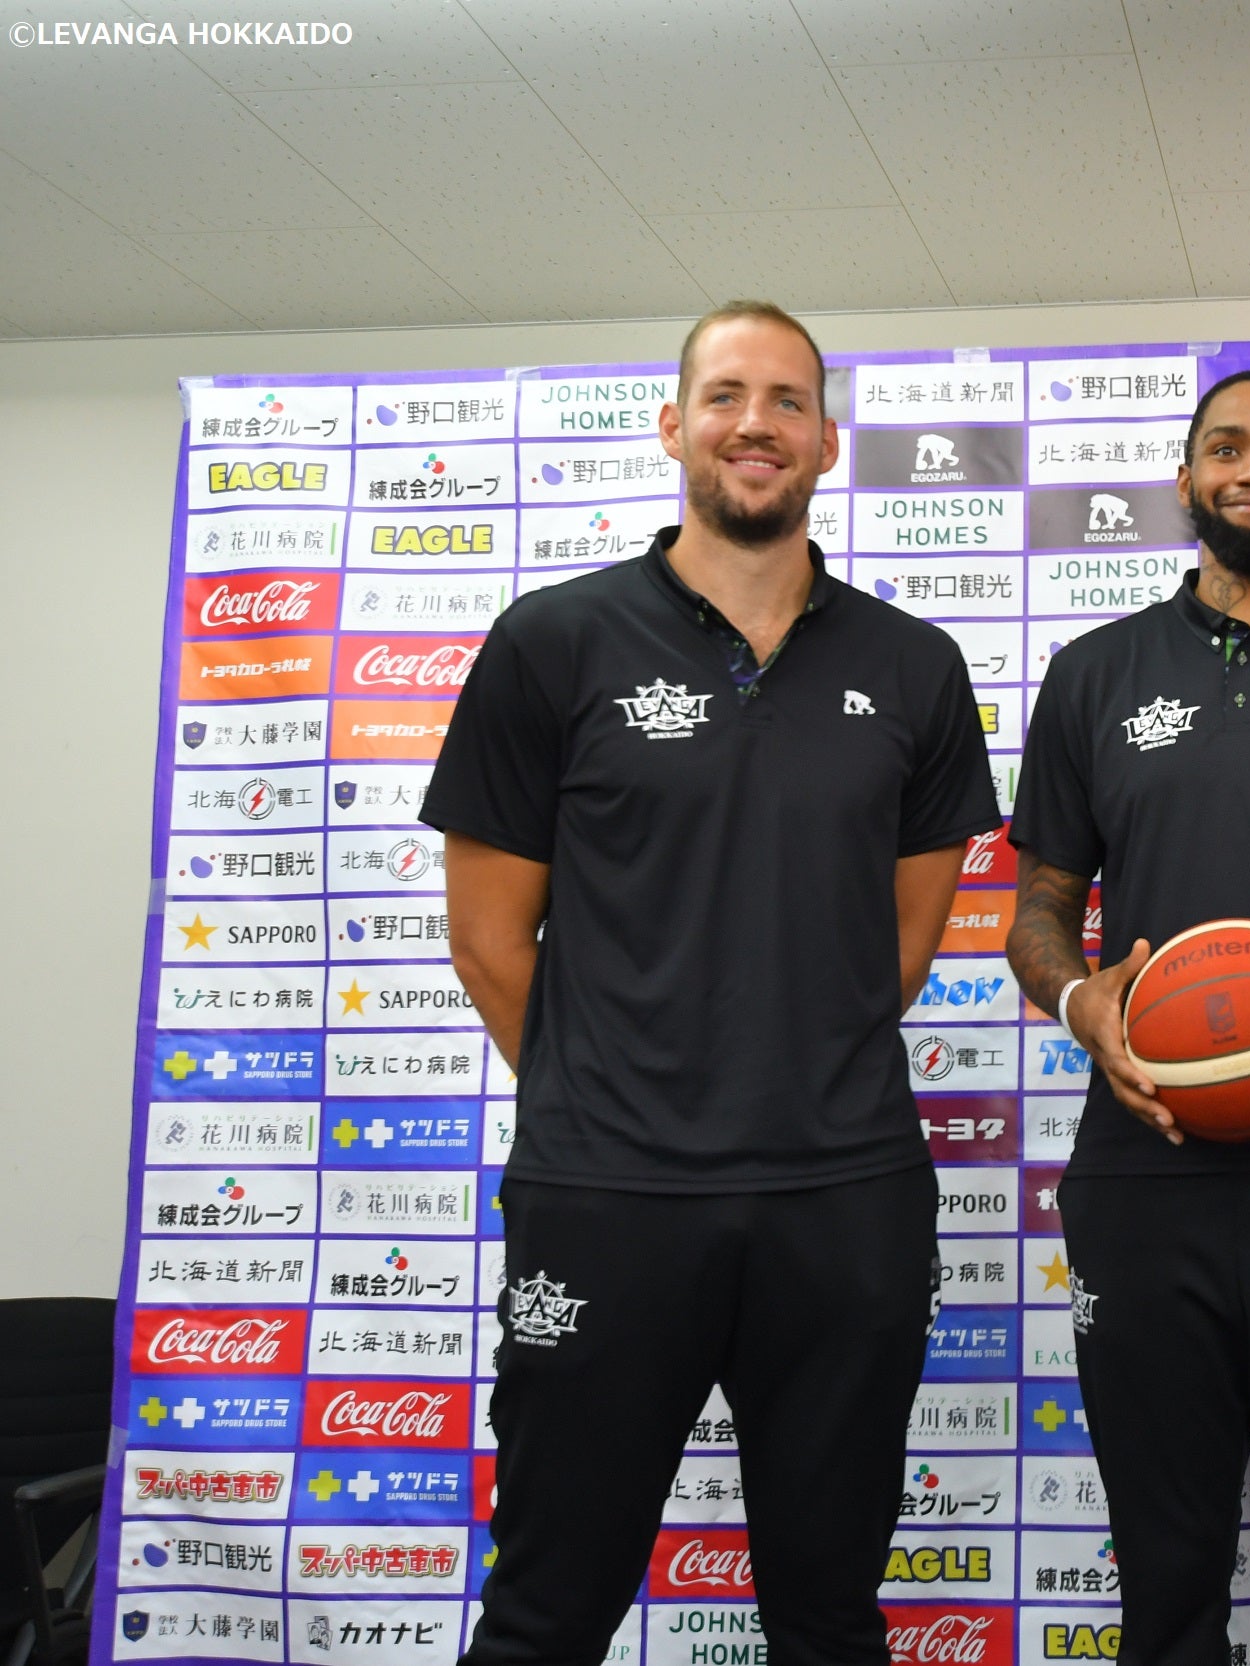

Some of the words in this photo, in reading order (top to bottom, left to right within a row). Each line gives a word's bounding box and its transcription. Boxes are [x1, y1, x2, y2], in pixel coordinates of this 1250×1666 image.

[542, 382, 666, 404] JOHNSON
[866, 382, 1014, 404] 北海道新聞
[1081, 373, 1186, 400] 野口観光
[407, 398, 505, 424] 野口観光
[560, 410, 651, 430] HOMES
[202, 418, 338, 438] 練成会グループ
[1039, 440, 1187, 464] 北海道新聞
[208, 462, 328, 492] EAGLE
[573, 454, 669, 483] 野口観光
[369, 478, 501, 501] 練成会グループ
[875, 498, 1004, 519] JOHNSON
[230, 530, 324, 551] 花川病院
[372, 524, 494, 555] EAGLE
[896, 525, 989, 546] HOMES
[1049, 557, 1178, 581] JOHNSON
[906, 574, 1012, 600] 野口観光
[1070, 586, 1162, 608] HOMES
[200, 580, 321, 627] Coca-Cola
[395, 593, 493, 614] 花川病院
[201, 657, 312, 679] トヨタカローラ札幌
[238, 720, 322, 747] 大藤学園
[352, 724, 448, 737] トヨタカローラ
[223, 851, 315, 877] 野口観光
[228, 925, 316, 944] SAPPORO
[373, 915, 450, 941] 野口観
[245, 1051, 314, 1069] サツドラ
[957, 1048, 1004, 1067] 電工
[200, 1123, 304, 1145] 花川病院
[400, 1119, 469, 1136] サツドラ
[157, 1203, 303, 1227] 練成会グループ
[367, 1192, 457, 1215] 花川病院
[148, 1260, 303, 1283] 北海道新聞
[330, 1273, 459, 1297] 練成会グループ
[147, 1318, 290, 1364] Coca-Cola
[319, 1331, 462, 1355] 北海道新聞
[931, 1329, 1007, 1346] サツドラ
[213, 1398, 290, 1417] サツドラ
[321, 1390, 452, 1438] Coca-Cola
[907, 1407, 997, 1429] 川病院
[387, 1471, 458, 1490] サツドラ
[178, 1540, 272, 1573] 野口観光
[884, 1547, 991, 1582] AGLE
[185, 1614, 280, 1643] 大藤学園
[339, 1621, 442, 1645] カオナビ
[886, 1615, 994, 1663] ca-Cola
[692, 1644, 768, 1665] HOME
